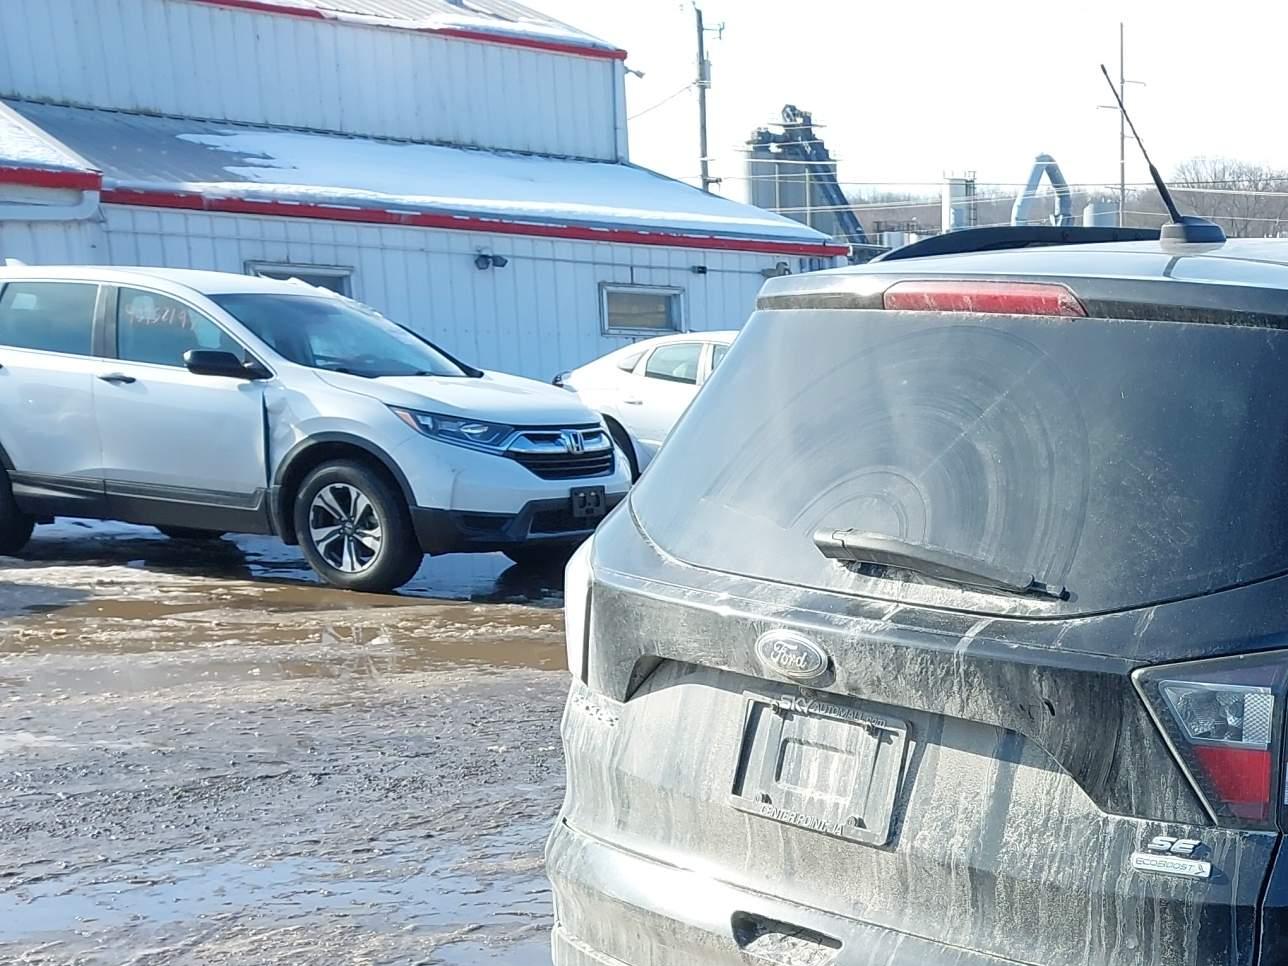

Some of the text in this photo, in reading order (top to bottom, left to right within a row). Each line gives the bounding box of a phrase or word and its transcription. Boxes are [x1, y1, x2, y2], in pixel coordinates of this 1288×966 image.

[770, 641, 808, 668] Ford
[760, 804, 797, 823] CENTER
[832, 824, 844, 836] IA
[1148, 836, 1202, 854] SE
[1136, 857, 1193, 872] ECOBOOST
